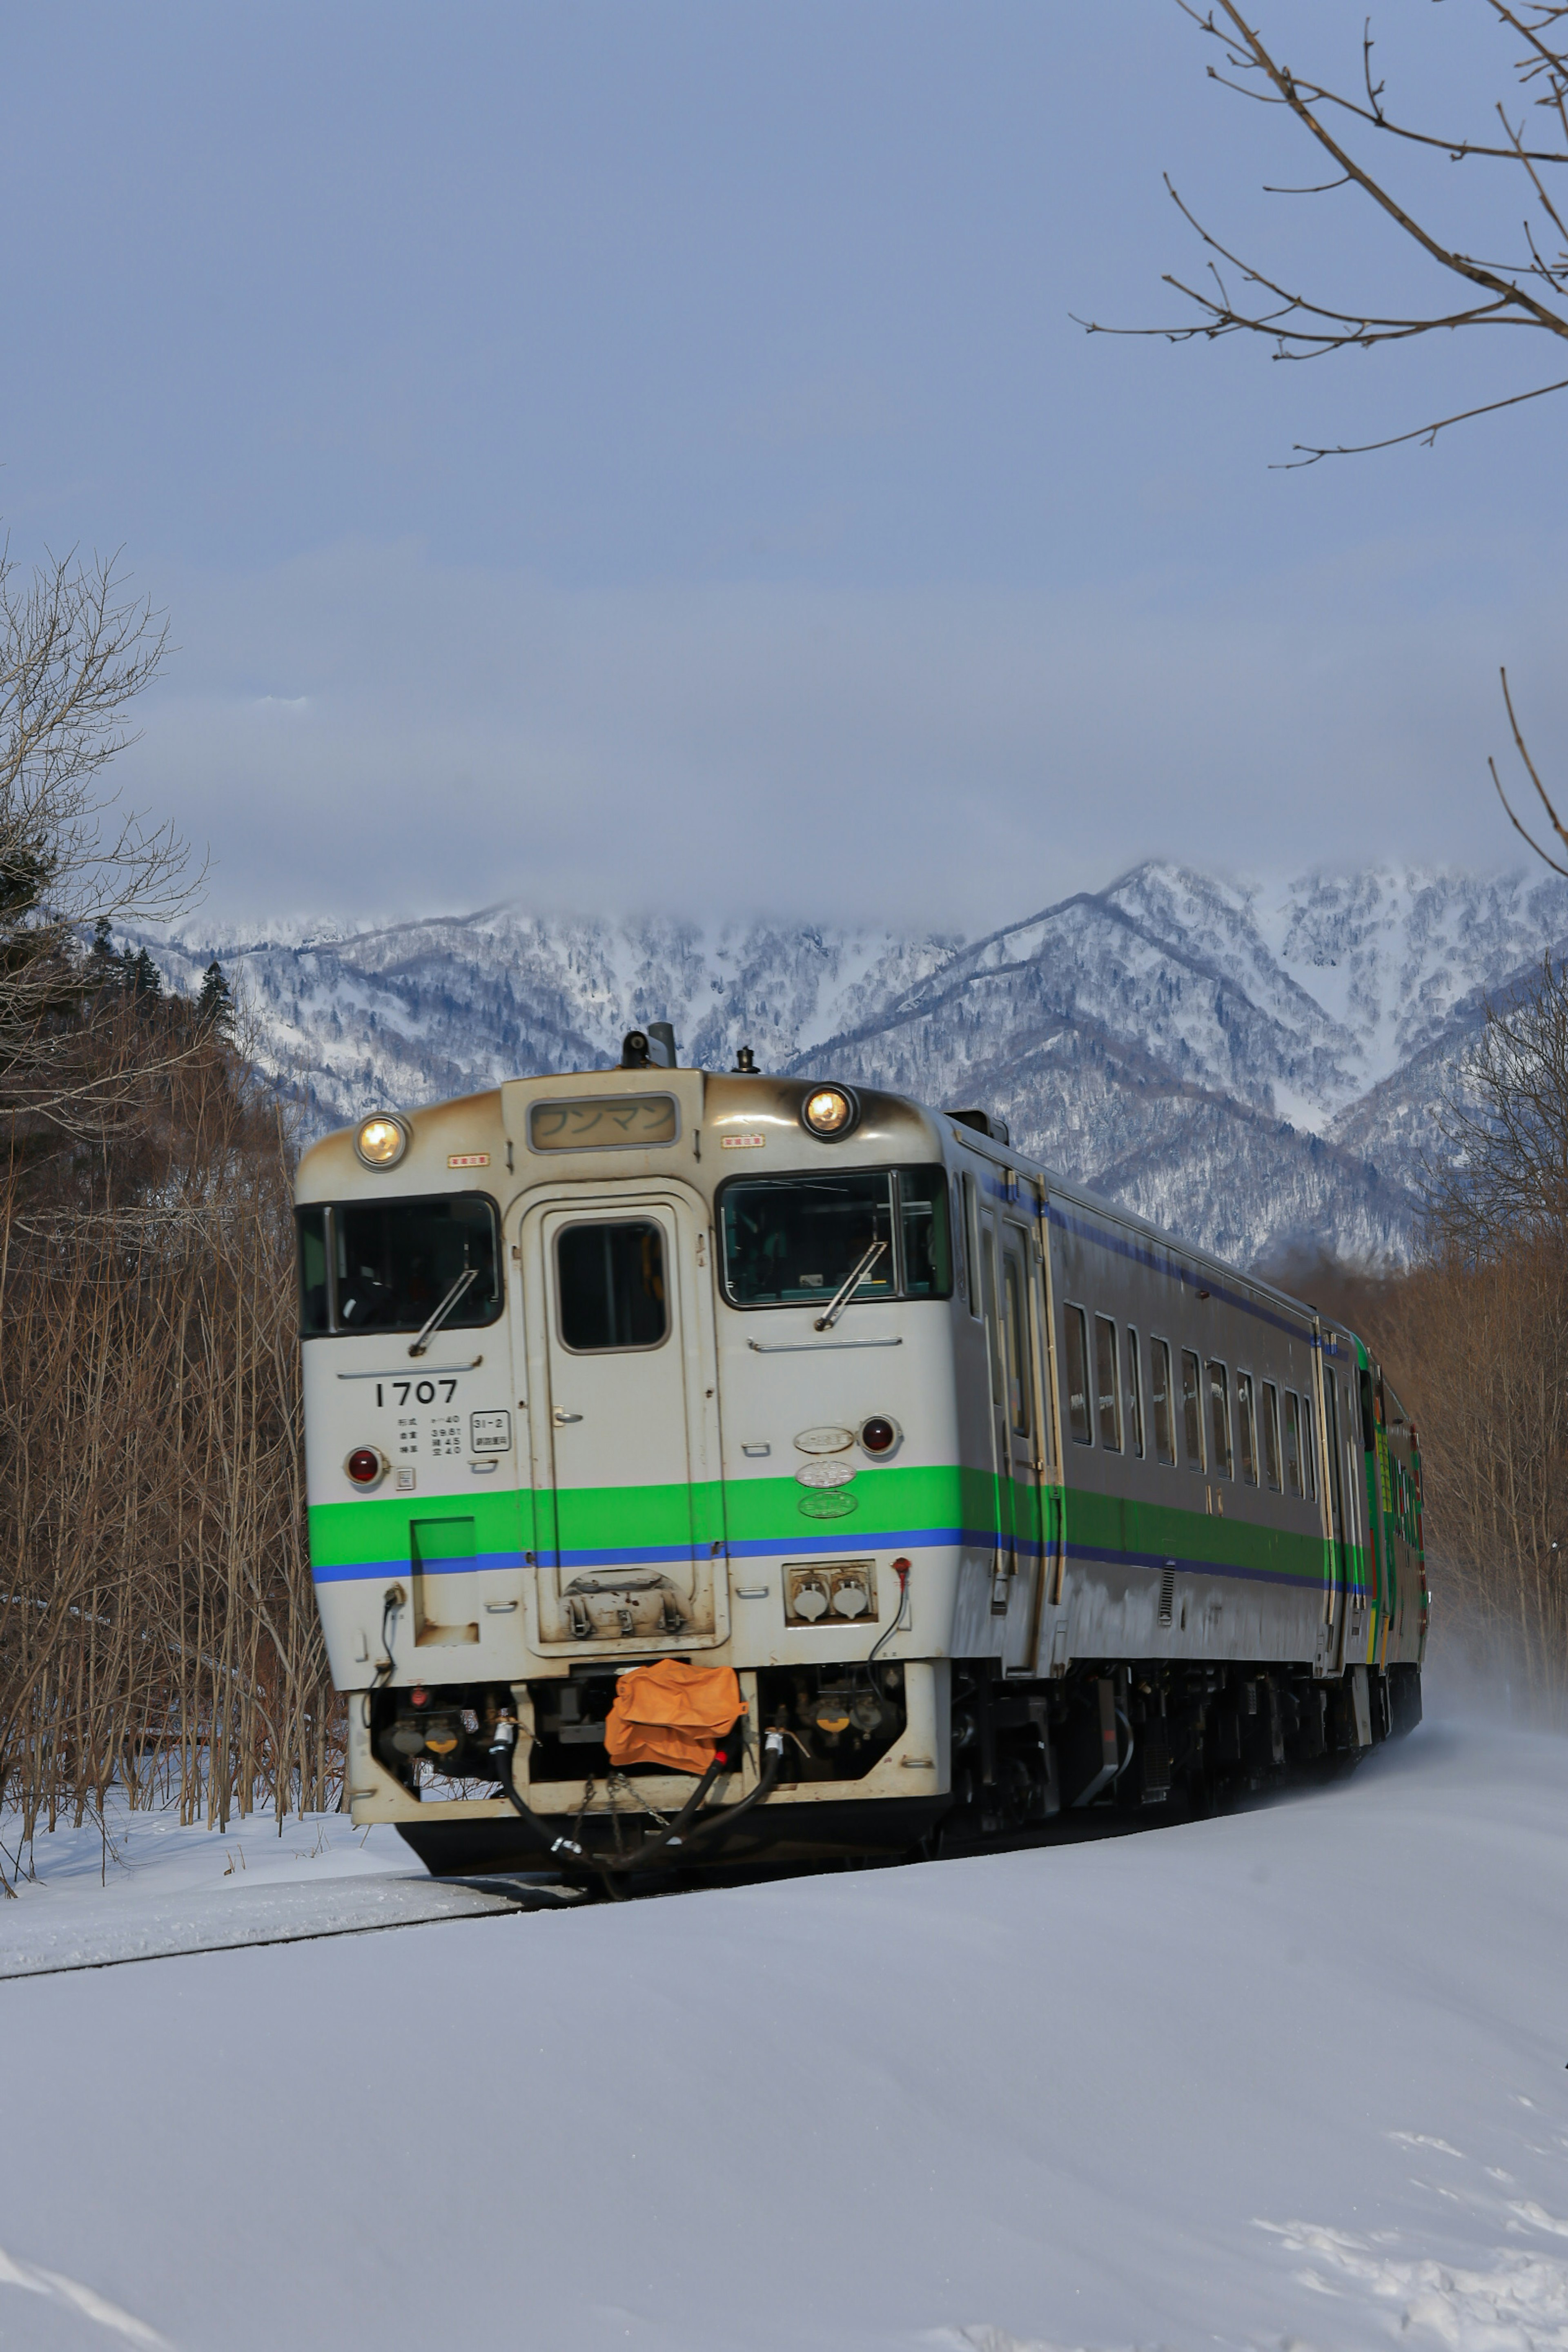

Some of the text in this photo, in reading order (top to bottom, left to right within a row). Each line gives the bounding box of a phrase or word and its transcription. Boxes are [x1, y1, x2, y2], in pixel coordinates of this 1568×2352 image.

[532, 1105, 674, 1136] ワンマン
[376, 1379, 458, 1408] 1707
[473, 1419, 503, 1428] 31-2
